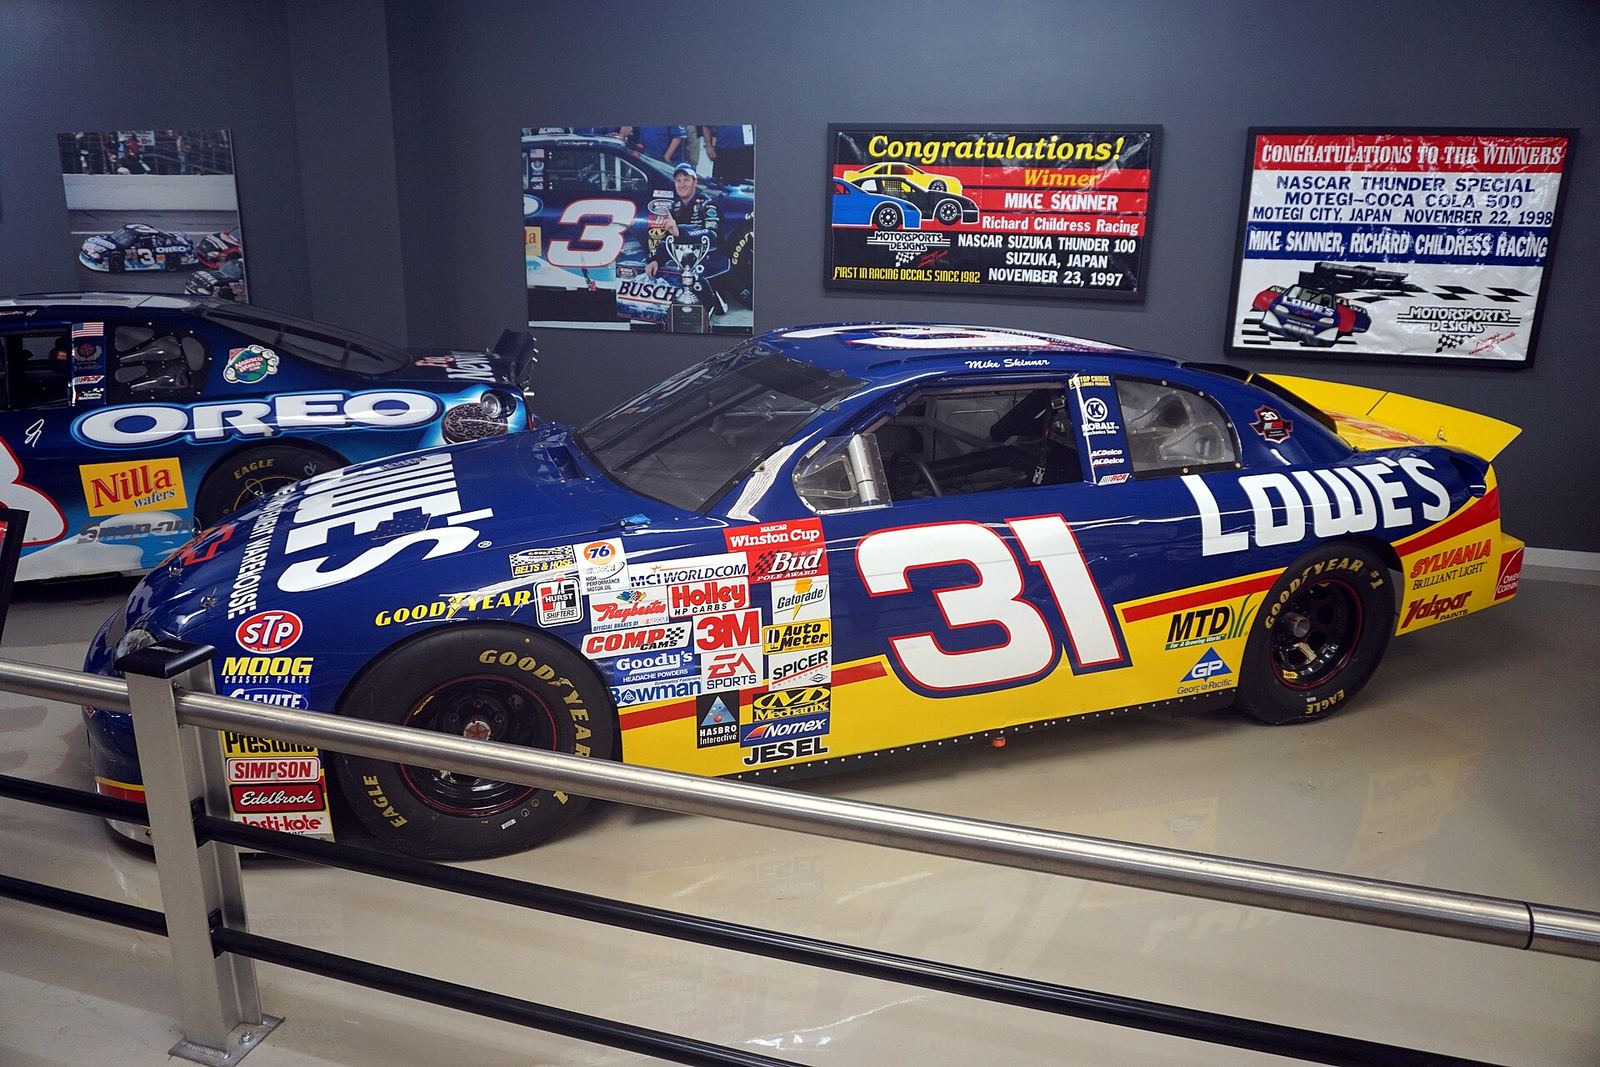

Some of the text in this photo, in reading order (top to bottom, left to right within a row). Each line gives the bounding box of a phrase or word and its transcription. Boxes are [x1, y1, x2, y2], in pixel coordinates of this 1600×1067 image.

[868, 135, 1124, 164] Congratulations!
[1262, 144, 1563, 165] CONGRATULATIONS TO THE WINNERS
[1024, 169, 1101, 187] Winner
[1276, 176, 1535, 193] NASCAR THUNDER SPECIAL
[1004, 193, 1118, 211] MIKE SKINNER
[1425, 194, 1475, 208] COLA
[1486, 195, 1522, 209] 500
[982, 216, 1139, 235] Richard Childress Racing
[1253, 207, 1553, 226] MOTEGI CITY, JAPAN NOVEMBER 22, 1998
[547, 199, 636, 266] 3
[875, 231, 943, 242] MOTORSPORTS
[890, 241, 927, 251] DESIGNS
[958, 234, 1136, 253] NASCAR SUZUKA THUNDER 100
[1249, 230, 1549, 257] MIKE SKINNER, RICHARD CHILDRESS RACING
[138, 248, 155, 266] 3
[1006, 252, 1108, 268] SUZUKA, JAPAN
[833, 267, 980, 283] FIRST IN RACING DECALS SINCE 1982
[989, 268, 1123, 287] NOVEMBER 23, 1997
[618, 281, 678, 299] BUSCH
[1410, 306, 1510, 321] MOTORSPORTS
[1431, 320, 1485, 333] DESIGNS
[965, 358, 1050, 369] Mike Skinner
[82, 391, 438, 444] OREO
[234, 458, 274, 480] EAGLE
[90, 465, 174, 510] Nilla
[133, 488, 176, 509] wafers
[1180, 456, 1451, 556] LOWE'S
[760, 524, 788, 533] NASCAR
[730, 529, 820, 548] Winston Cup
[589, 545, 610, 559] 76
[768, 548, 824, 574] Bud
[1410, 539, 1492, 579] SYLVANIA
[514, 563, 540, 575] BELTS
[541, 561, 549, 571] &
[550, 559, 573, 570] HOSE
[630, 563, 747, 587] MCI WORLDCOM
[756, 569, 818, 582] POLE AWARD
[1412, 562, 1485, 591] BRILLIANT LIGHT
[228, 535, 273, 620] WAREHOUSE
[586, 578, 621, 587] PERFORMANCE
[545, 593, 573, 603] HURST
[671, 581, 745, 608] Holley
[777, 588, 824, 609] Gatorade
[856, 513, 1124, 691] 31
[1265, 558, 1364, 629] GOODYEAR
[375, 590, 531, 627] GOODYEAR
[546, 609, 575, 620] SHIFTERS
[592, 600, 666, 622] Raybestos
[674, 603, 728, 616] HP CARBS
[1400, 591, 1473, 629] Valspar
[1440, 609, 1469, 622] PAINTS
[243, 615, 294, 645] STP
[593, 623, 613, 632] OFFICIAL
[614, 620, 632, 629] BRAKES
[696, 610, 760, 651] 3M
[783, 623, 821, 637] Auto
[1167, 606, 1230, 643] MTD
[586, 628, 666, 654] COMP
[640, 640, 678, 651] CAMS
[779, 633, 829, 650] Meter
[221, 657, 314, 676] MOOG
[616, 651, 694, 671] Goody's
[772, 650, 828, 681] SPICER
[1191, 659, 1223, 678] GP
[224, 676, 310, 684] CHASSIS PARTS
[622, 672, 657, 683] HEADACHE
[657, 669, 689, 679] POWDERS
[706, 674, 757, 690] SPORTS
[754, 701, 829, 721] Mechanix
[1305, 689, 1345, 715] EAGLE
[700, 724, 738, 737] HASBRO
[764, 718, 828, 738] Nomex
[700, 733, 738, 746] Interactive
[744, 737, 829, 766] JESEL
[235, 762, 312, 779] SIMPSON
[240, 790, 316, 806] Edelbrock
[363, 775, 408, 828] EAGLE
